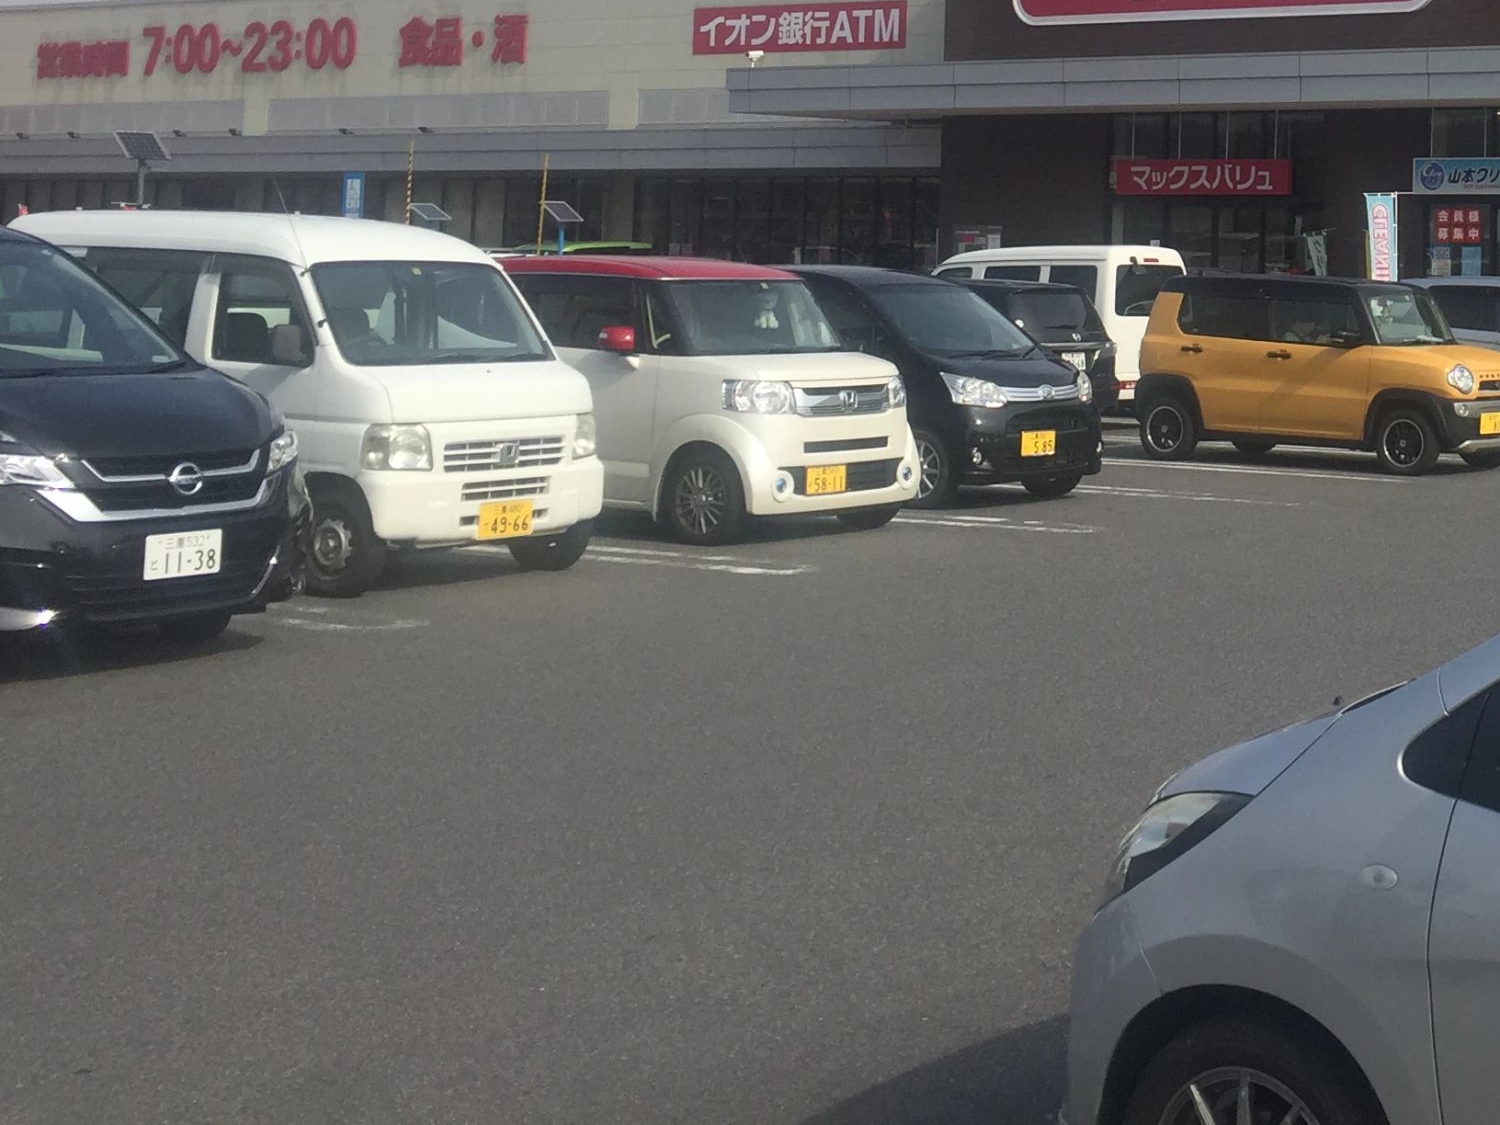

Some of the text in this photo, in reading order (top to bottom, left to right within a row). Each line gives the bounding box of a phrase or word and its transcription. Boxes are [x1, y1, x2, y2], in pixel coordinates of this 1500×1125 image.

[700, 8, 900, 47] イオン銀行ATM
[1130, 164, 1273, 191] マックスバリュ
[1437, 210, 1480, 223] 会員様
[1437, 227, 1480, 240] 募集中
[491, 515, 529, 534] 49-66
[165, 548, 216, 574] 11-38
